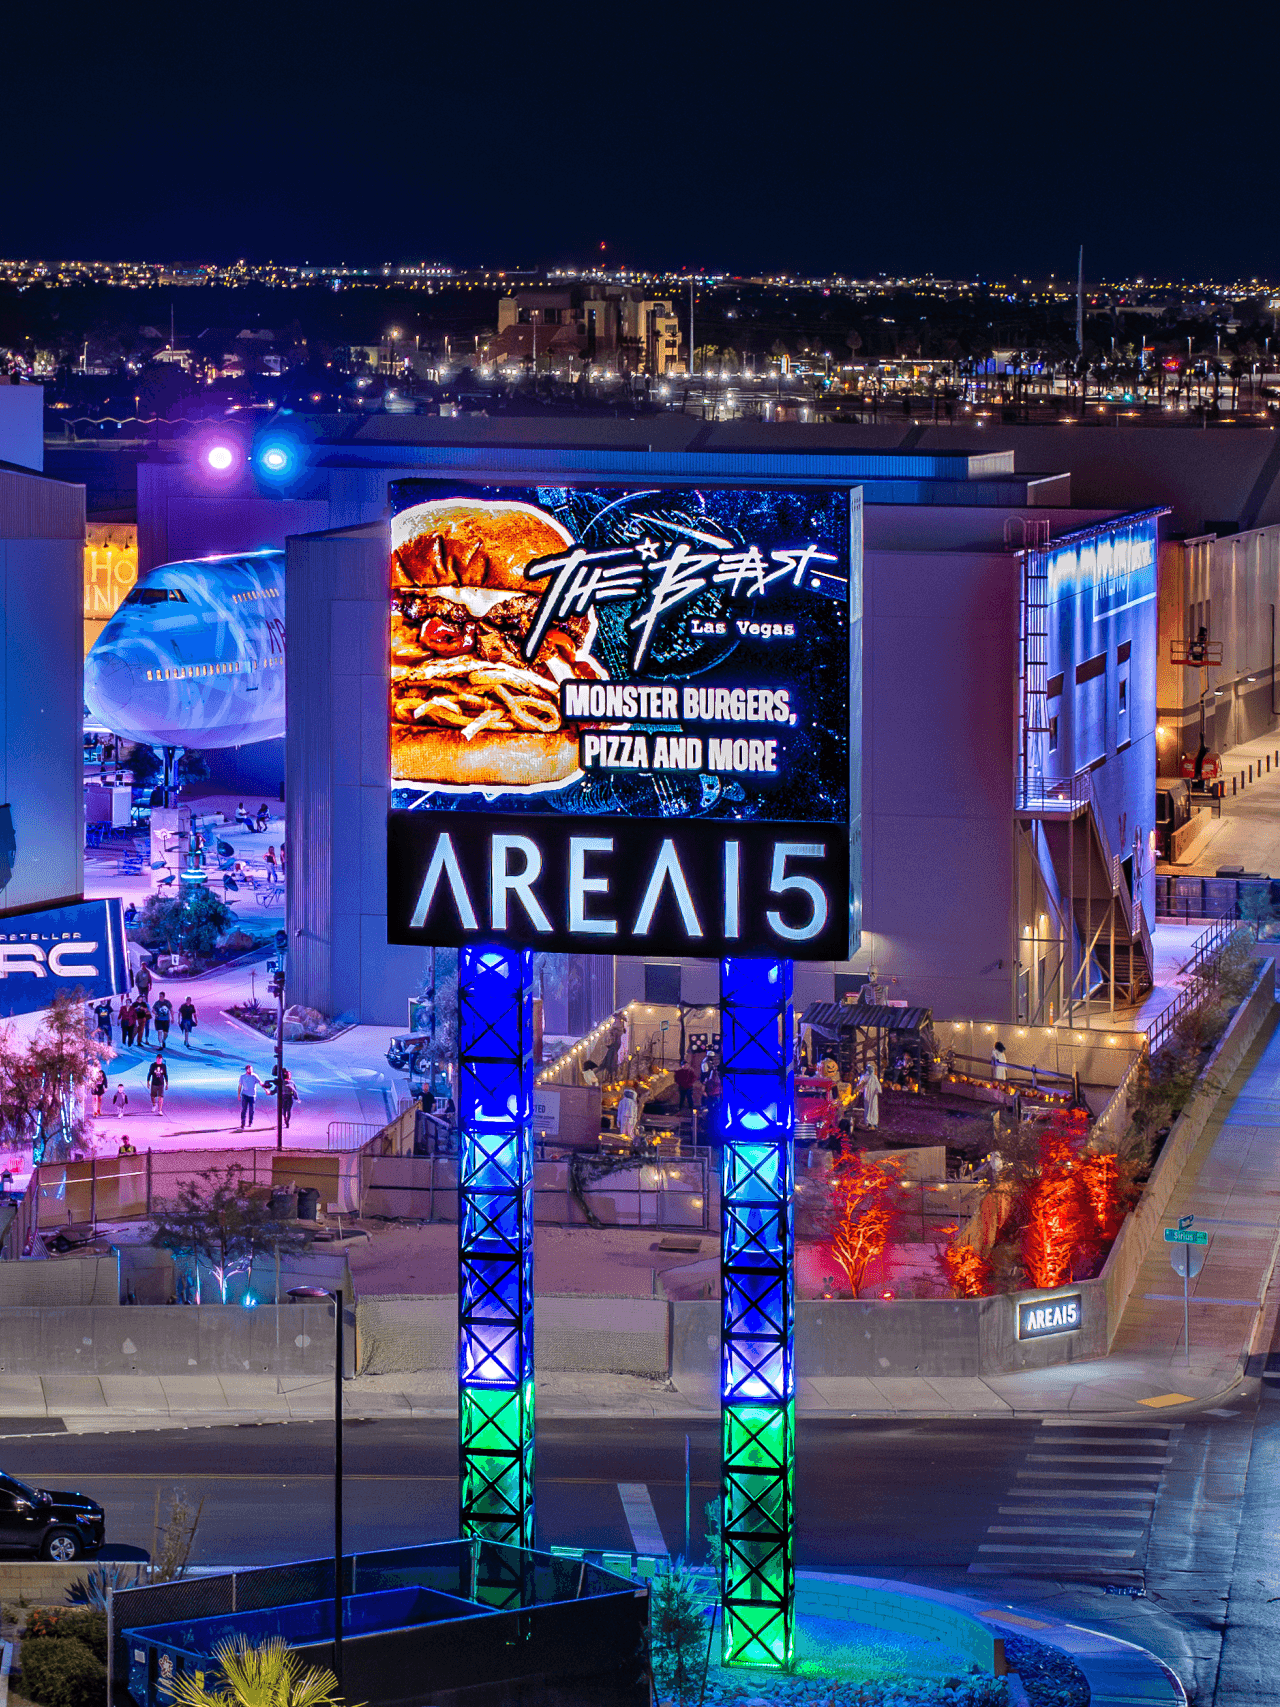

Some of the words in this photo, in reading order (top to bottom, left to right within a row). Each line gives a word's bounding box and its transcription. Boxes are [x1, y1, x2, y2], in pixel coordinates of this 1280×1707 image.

[524, 545, 643, 656] THE
[691, 619, 726, 635] Las
[736, 620, 795, 638] Vegas
[565, 685, 677, 719] MONSTER
[683, 688, 798, 726] BURGERS,
[584, 735, 648, 768] PIZZA
[652, 737, 702, 770] AND
[708, 739, 778, 772] MORE
[1027, 1303, 1077, 1331] AREA15
